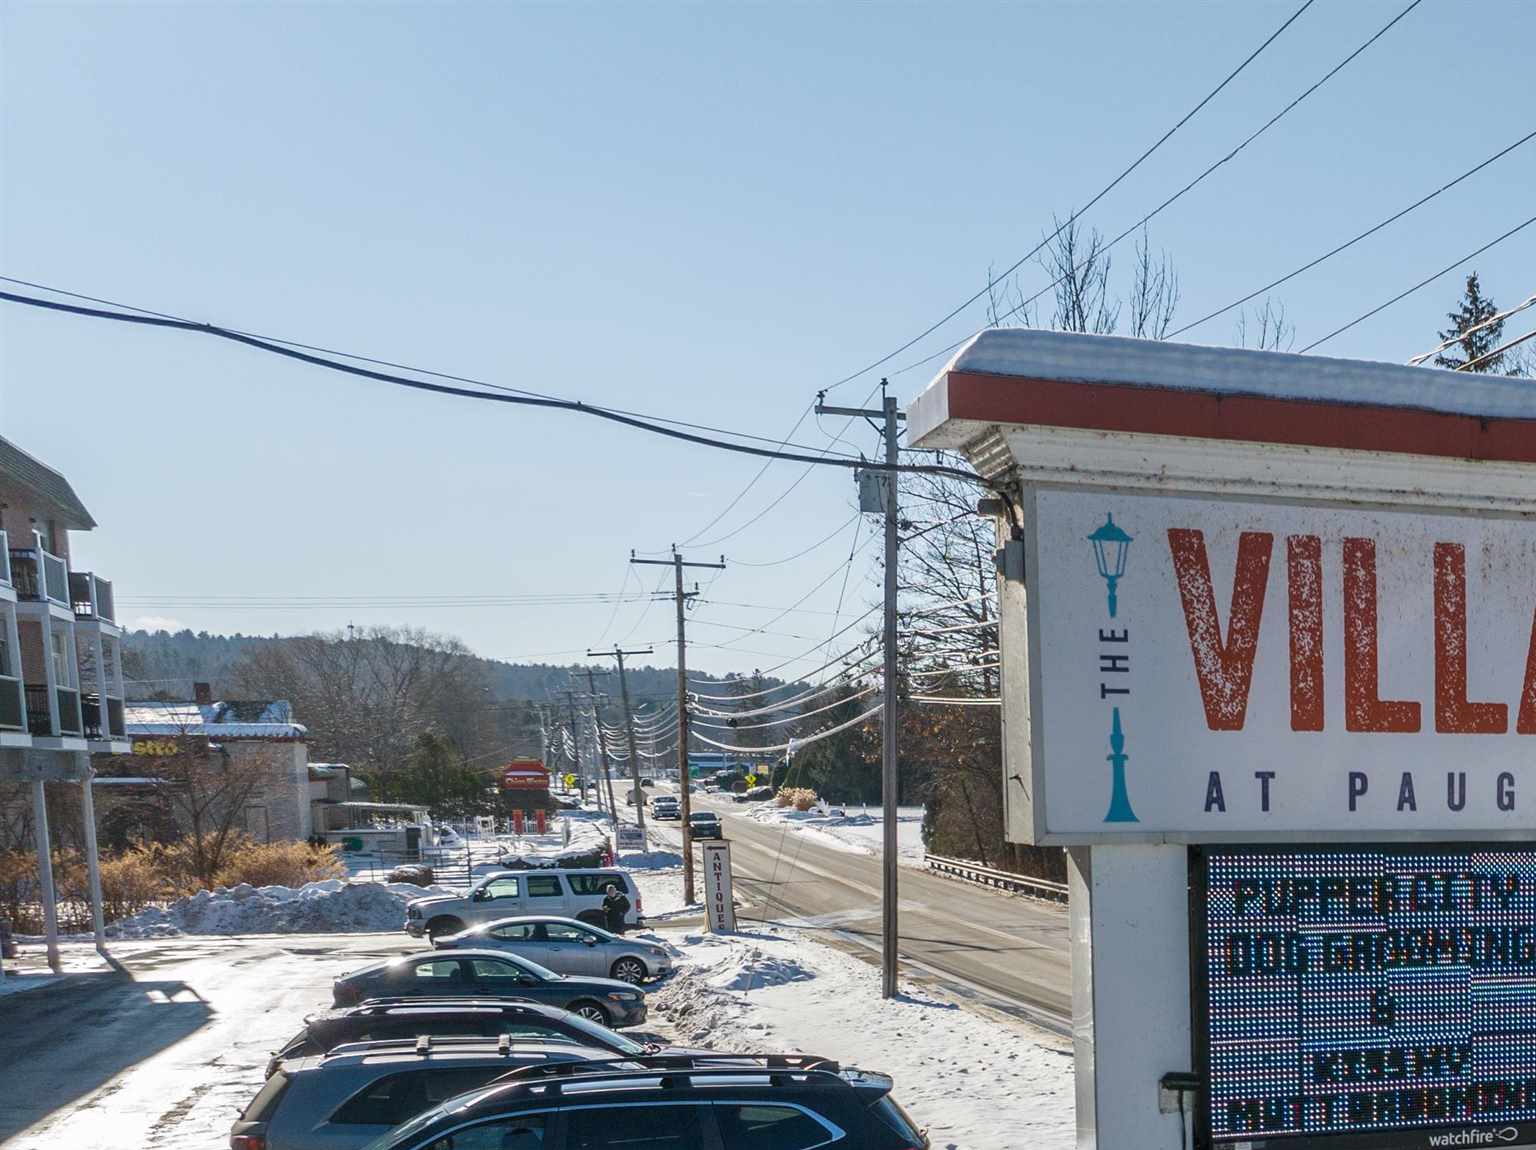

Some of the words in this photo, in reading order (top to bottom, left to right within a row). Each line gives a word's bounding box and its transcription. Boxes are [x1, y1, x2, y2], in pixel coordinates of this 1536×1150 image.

[1098, 627, 1131, 699] THE
[1204, 770, 1276, 812] AT
[1410, 873, 1521, 912] CITY
[1226, 932, 1307, 976] DOG
[1323, 926, 1536, 973] GROOMING
[1429, 1129, 1493, 1147] watchfire
